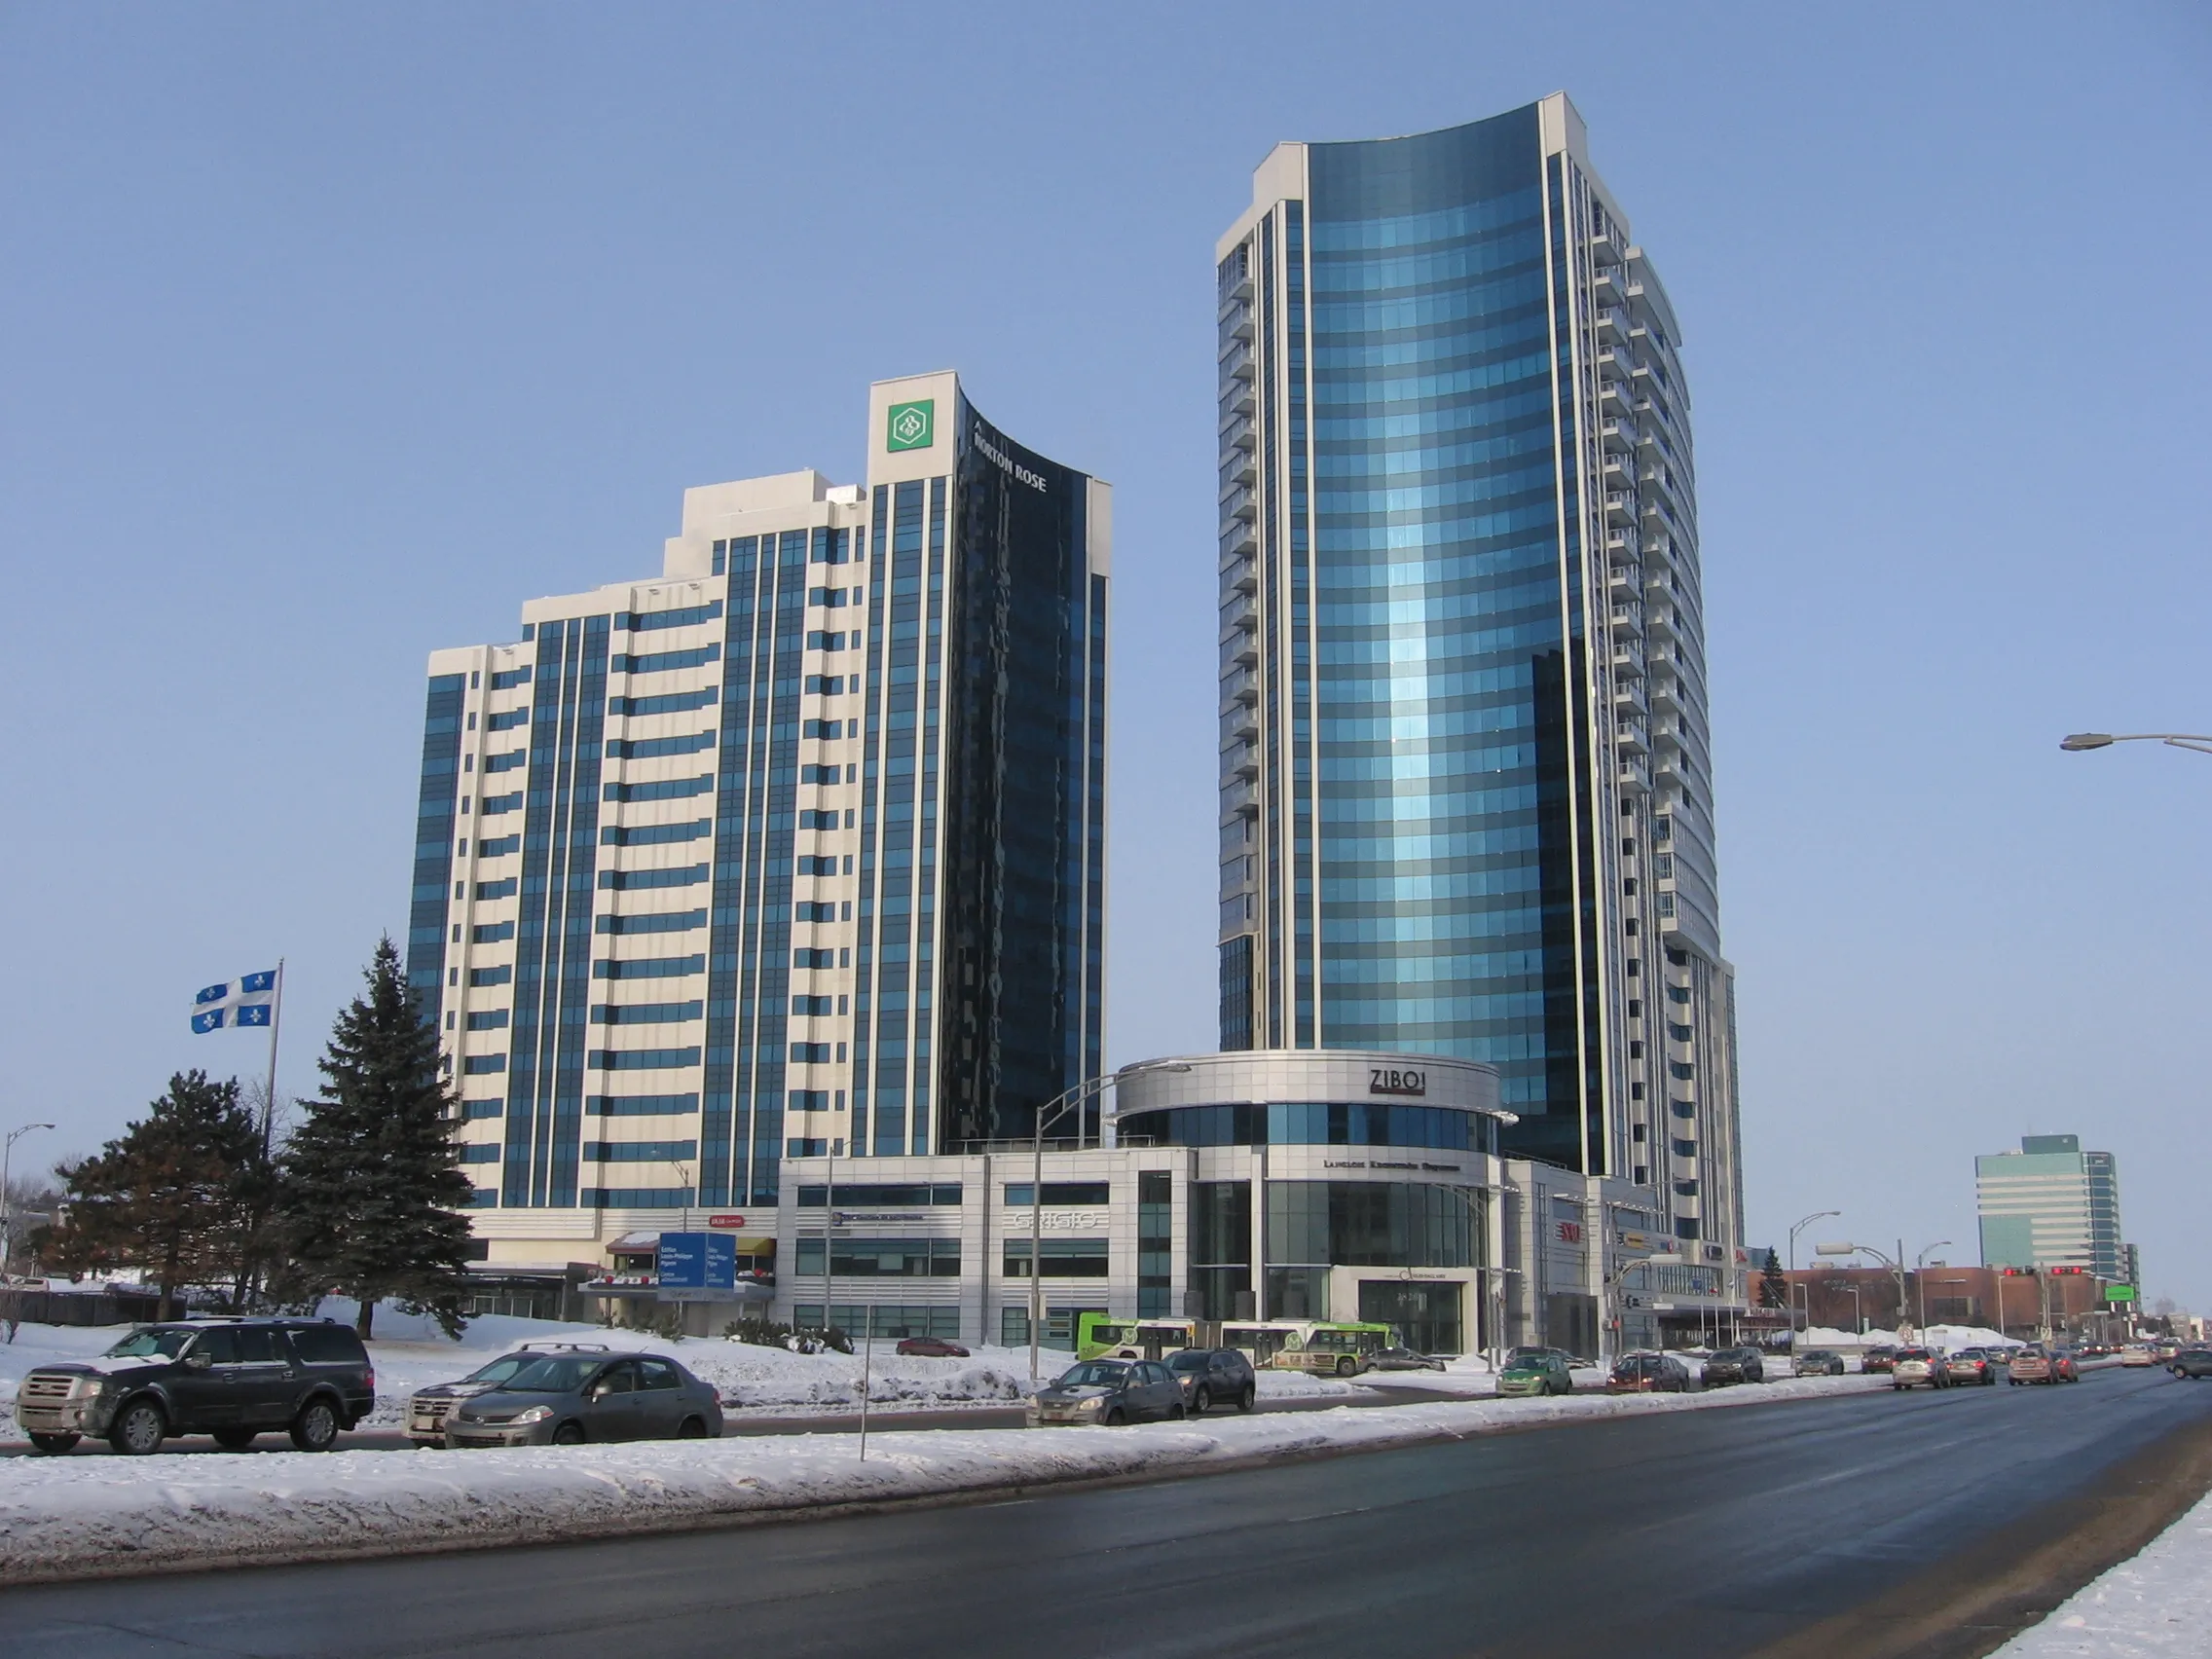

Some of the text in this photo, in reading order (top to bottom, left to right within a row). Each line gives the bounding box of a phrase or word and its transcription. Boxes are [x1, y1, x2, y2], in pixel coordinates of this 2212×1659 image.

[974, 431, 1047, 493] NORTON ROSE
[1371, 1069, 1425, 1089] ZIBO!
